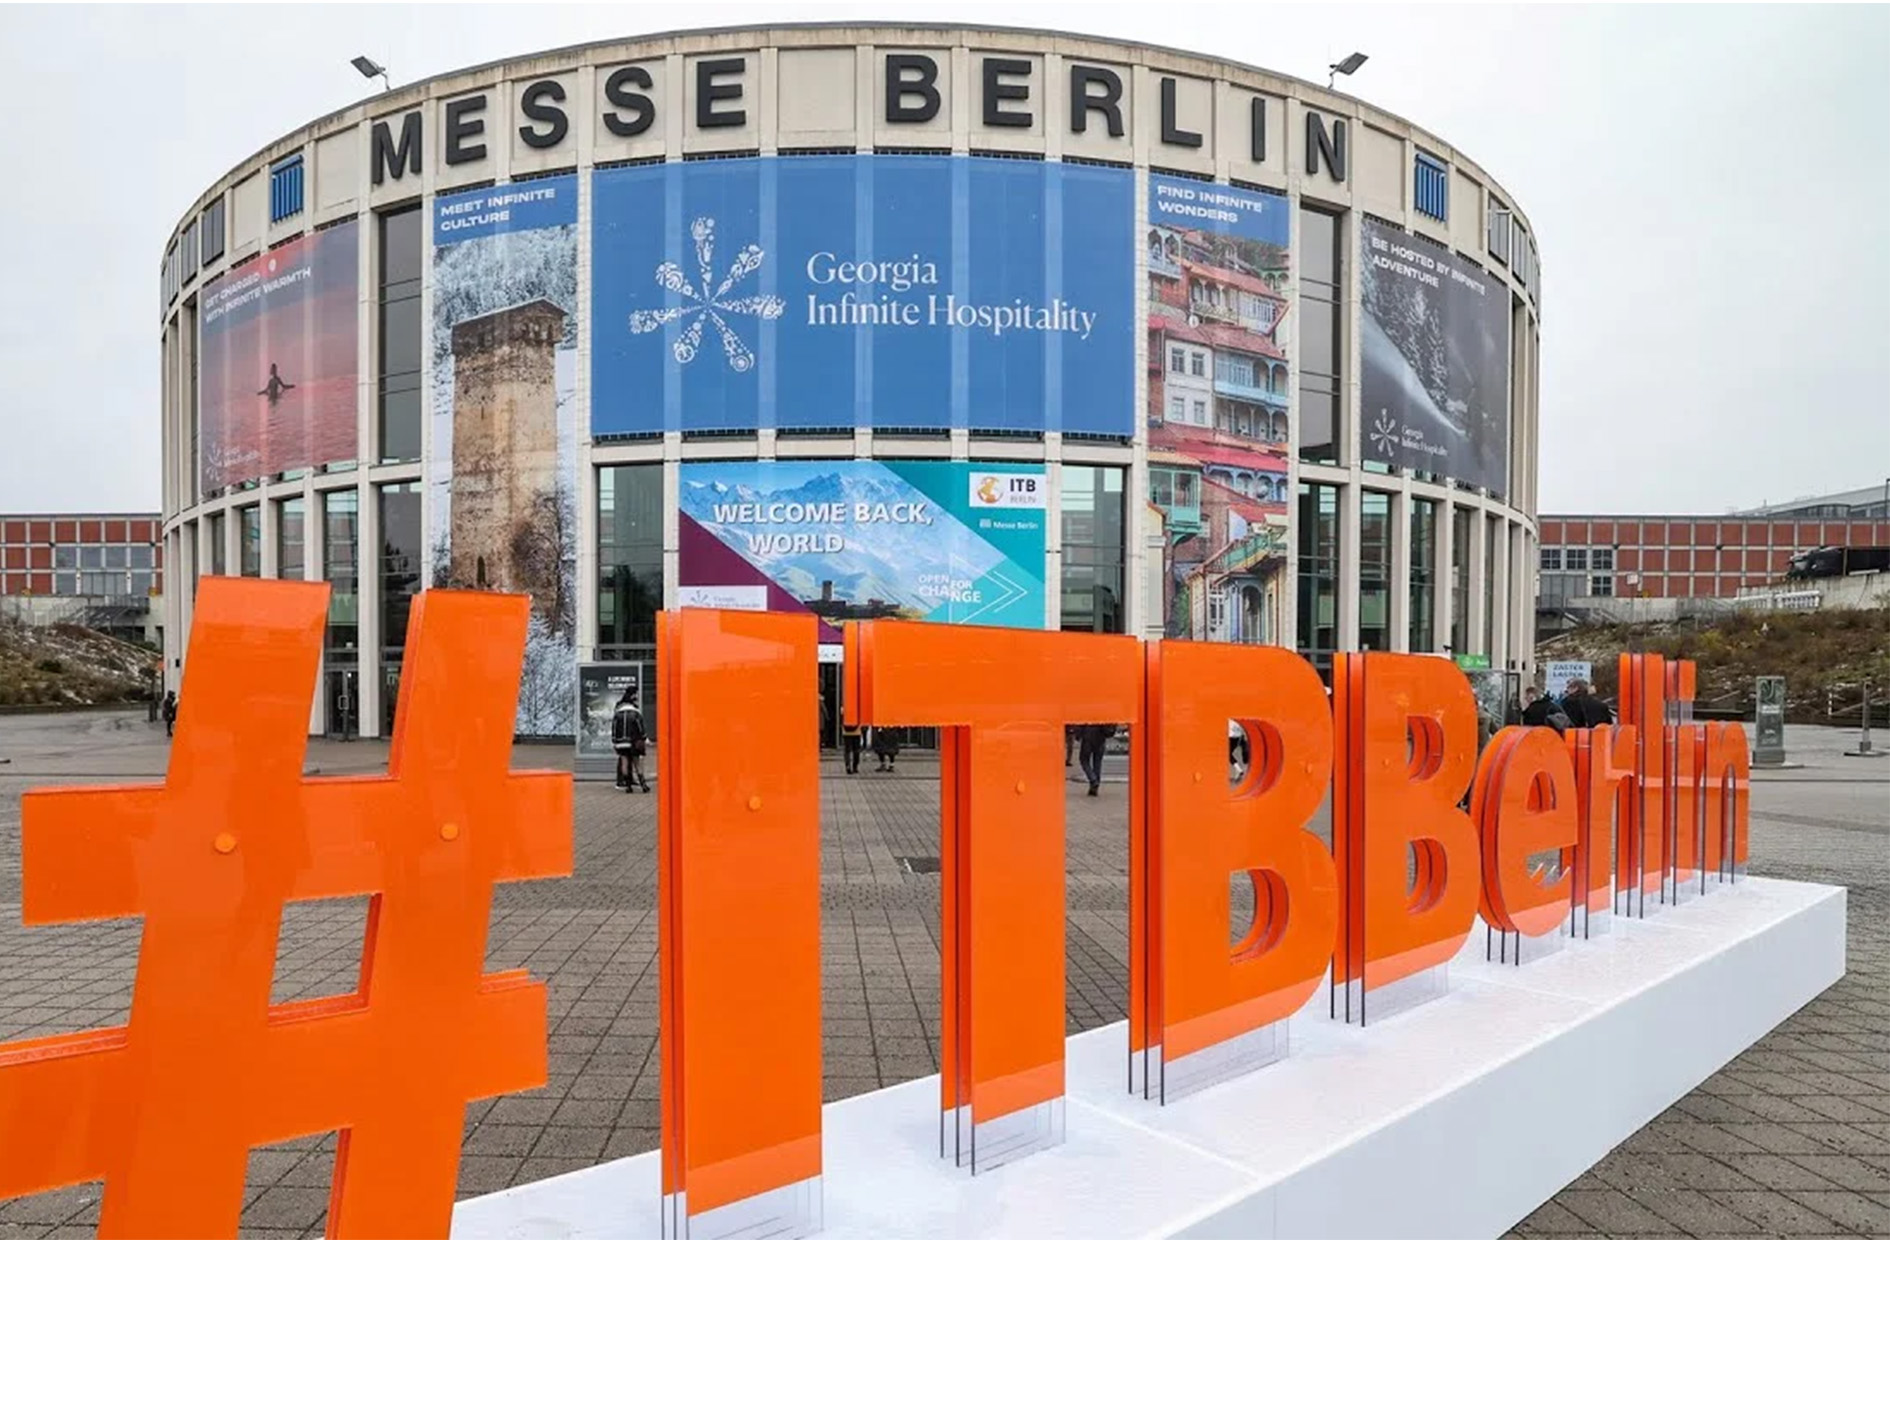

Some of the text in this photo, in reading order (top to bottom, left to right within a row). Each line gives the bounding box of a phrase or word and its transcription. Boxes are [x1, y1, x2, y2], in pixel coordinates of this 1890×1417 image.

[371, 53, 1346, 185] MESSE BERLIN
[440, 188, 556, 217] MEET INFINITE
[1157, 185, 1263, 213] FIND INFINITE
[1157, 200, 1239, 223] WONDERS
[440, 210, 510, 231] CULTURE
[1371, 237, 1389, 252] BE
[1390, 243, 1436, 269] HOSTED
[1436, 261, 1451, 276] BY
[262, 266, 312, 295] WARMTH
[806, 251, 939, 292] Georgia
[1372, 254, 1440, 288] ADVENTURE
[806, 292, 1097, 340] Infinite Hospitality
[1009, 478, 1037, 493] ITB
[713, 502, 934, 526] WELCOME BACK,
[749, 532, 845, 555] WORLD
[918, 574, 973, 590] OPEN FOR
[918, 584, 982, 604] CHANGE
